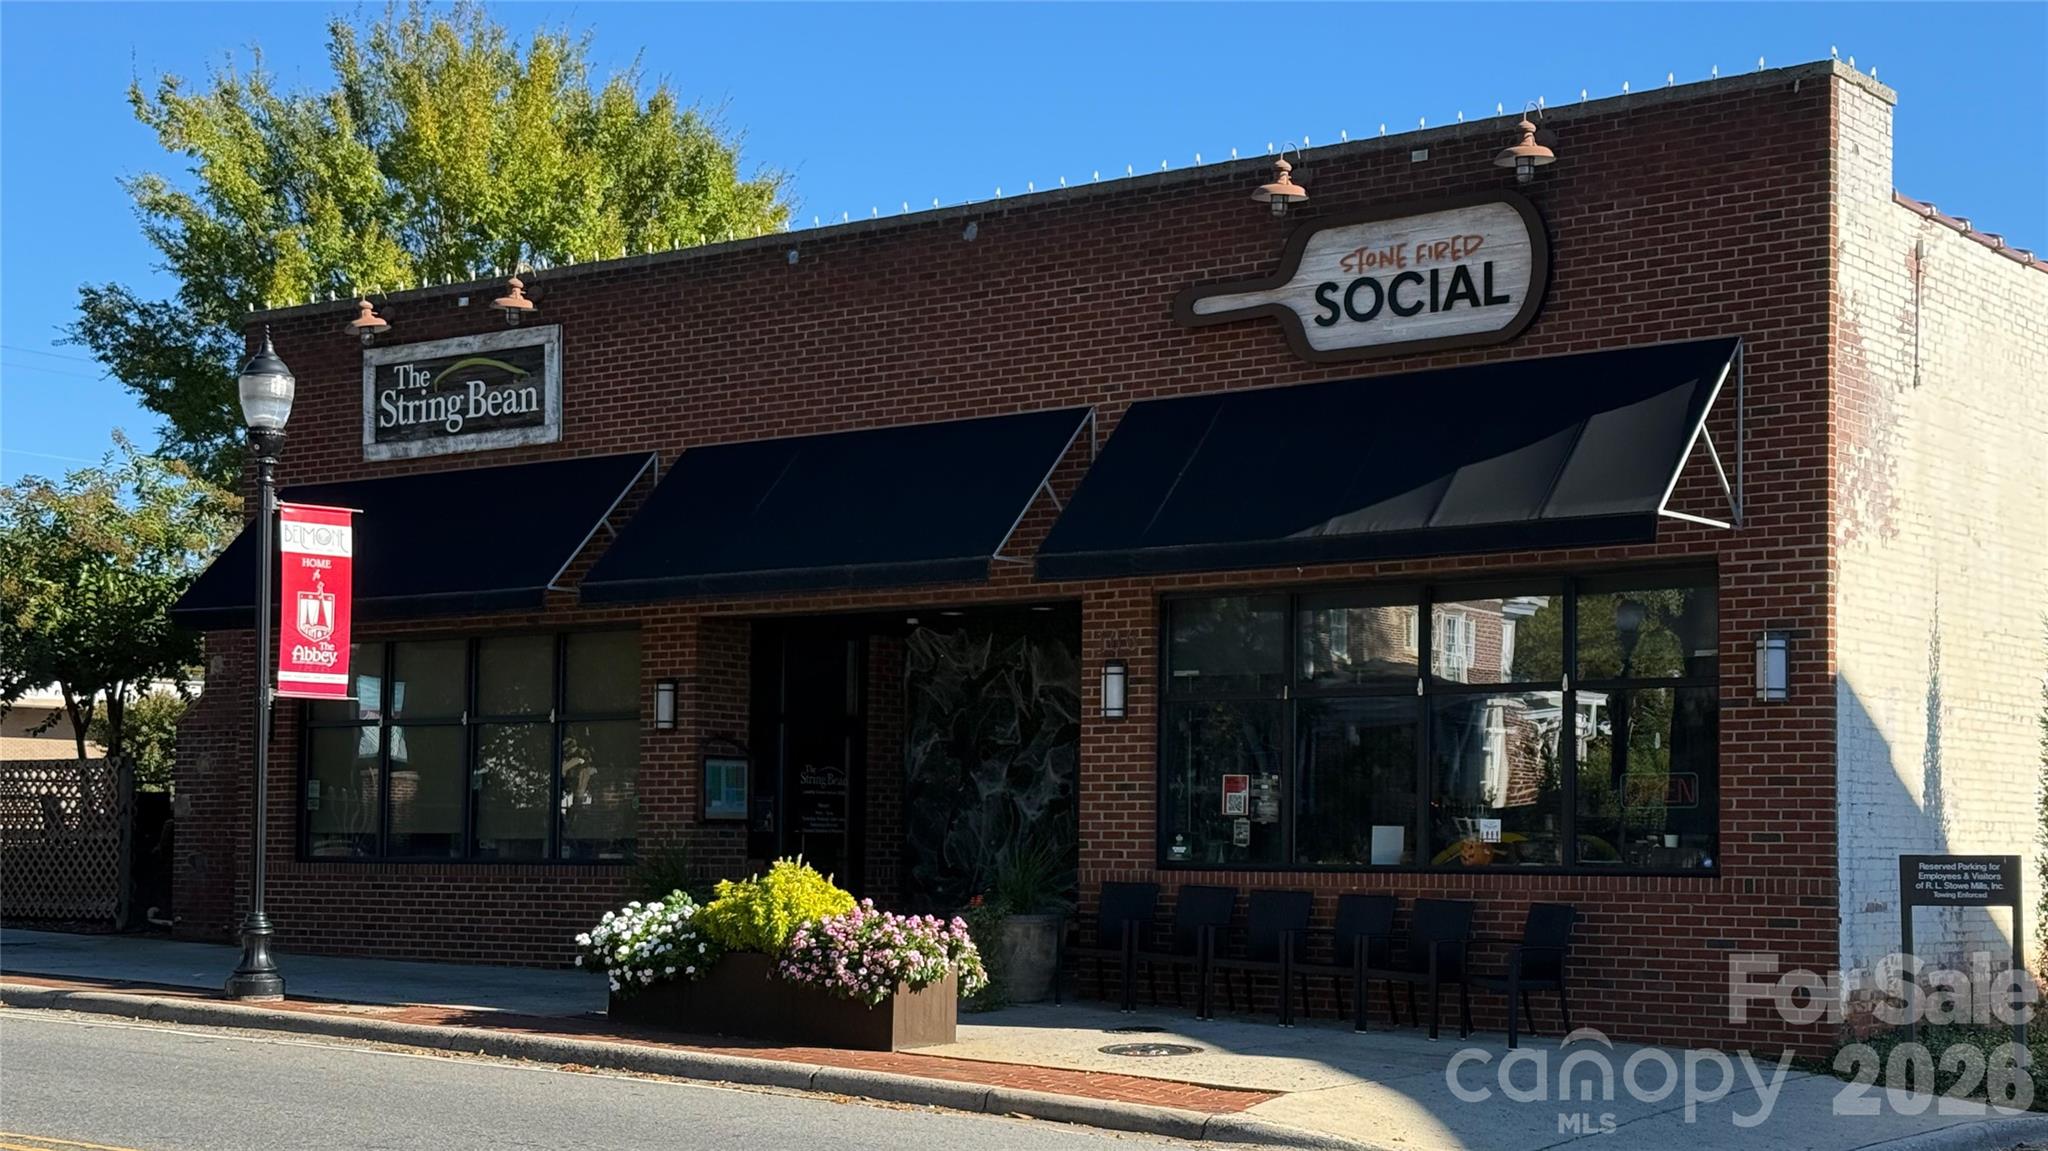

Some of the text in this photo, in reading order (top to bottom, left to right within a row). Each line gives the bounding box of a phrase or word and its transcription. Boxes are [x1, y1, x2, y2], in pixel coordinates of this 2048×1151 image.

[1339, 234, 1484, 275] STONE FIRED
[1314, 260, 1511, 328] SOCIAL
[394, 364, 431, 390] The
[379, 379, 540, 434] String Bean
[302, 558, 332, 569] HOME
[320, 642, 335, 651] The
[1624, 777, 1697, 806] EN
[1919, 862, 2000, 872] Reserved Parking for
[1918, 872, 2001, 881] Employees & Visitors
[1915, 881, 1924, 889] of
[1944, 882, 1969, 890] Stowe
[1933, 891, 1956, 899] Towing
